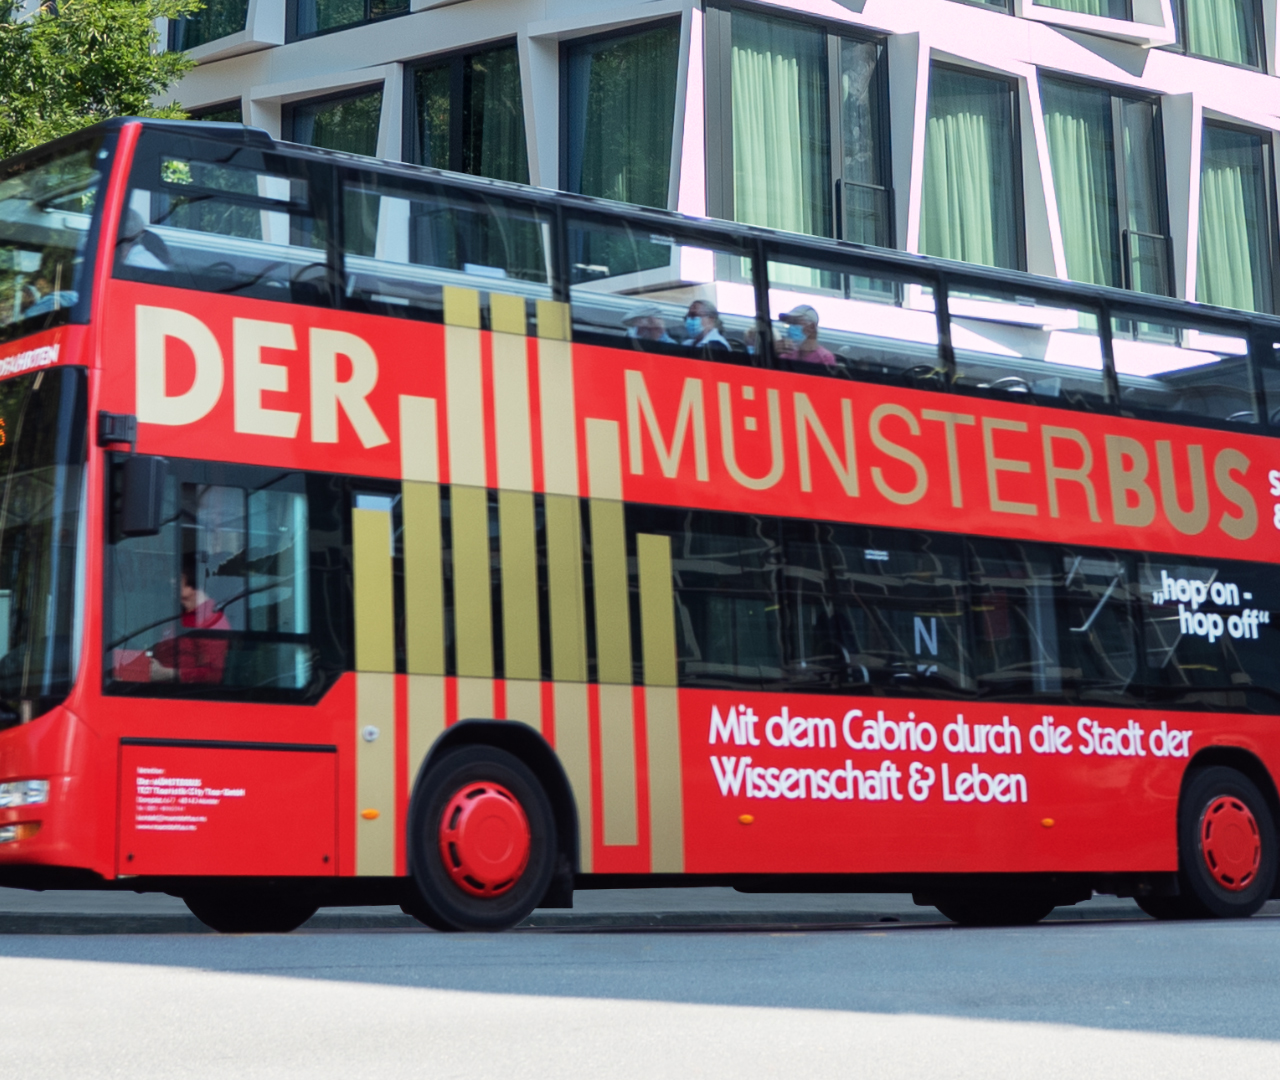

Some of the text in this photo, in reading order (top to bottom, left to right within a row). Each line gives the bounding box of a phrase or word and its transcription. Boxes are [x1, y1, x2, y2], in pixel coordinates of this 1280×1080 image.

[135, 304, 1258, 541] DER MÜNSTERBUS
[1210, 581, 1240, 606] on
[1178, 603, 1224, 643] hop
[709, 704, 1193, 757] Mit dem Cabrio durch die Stadt der
[709, 756, 1028, 803] Wissenschaft & Leben
